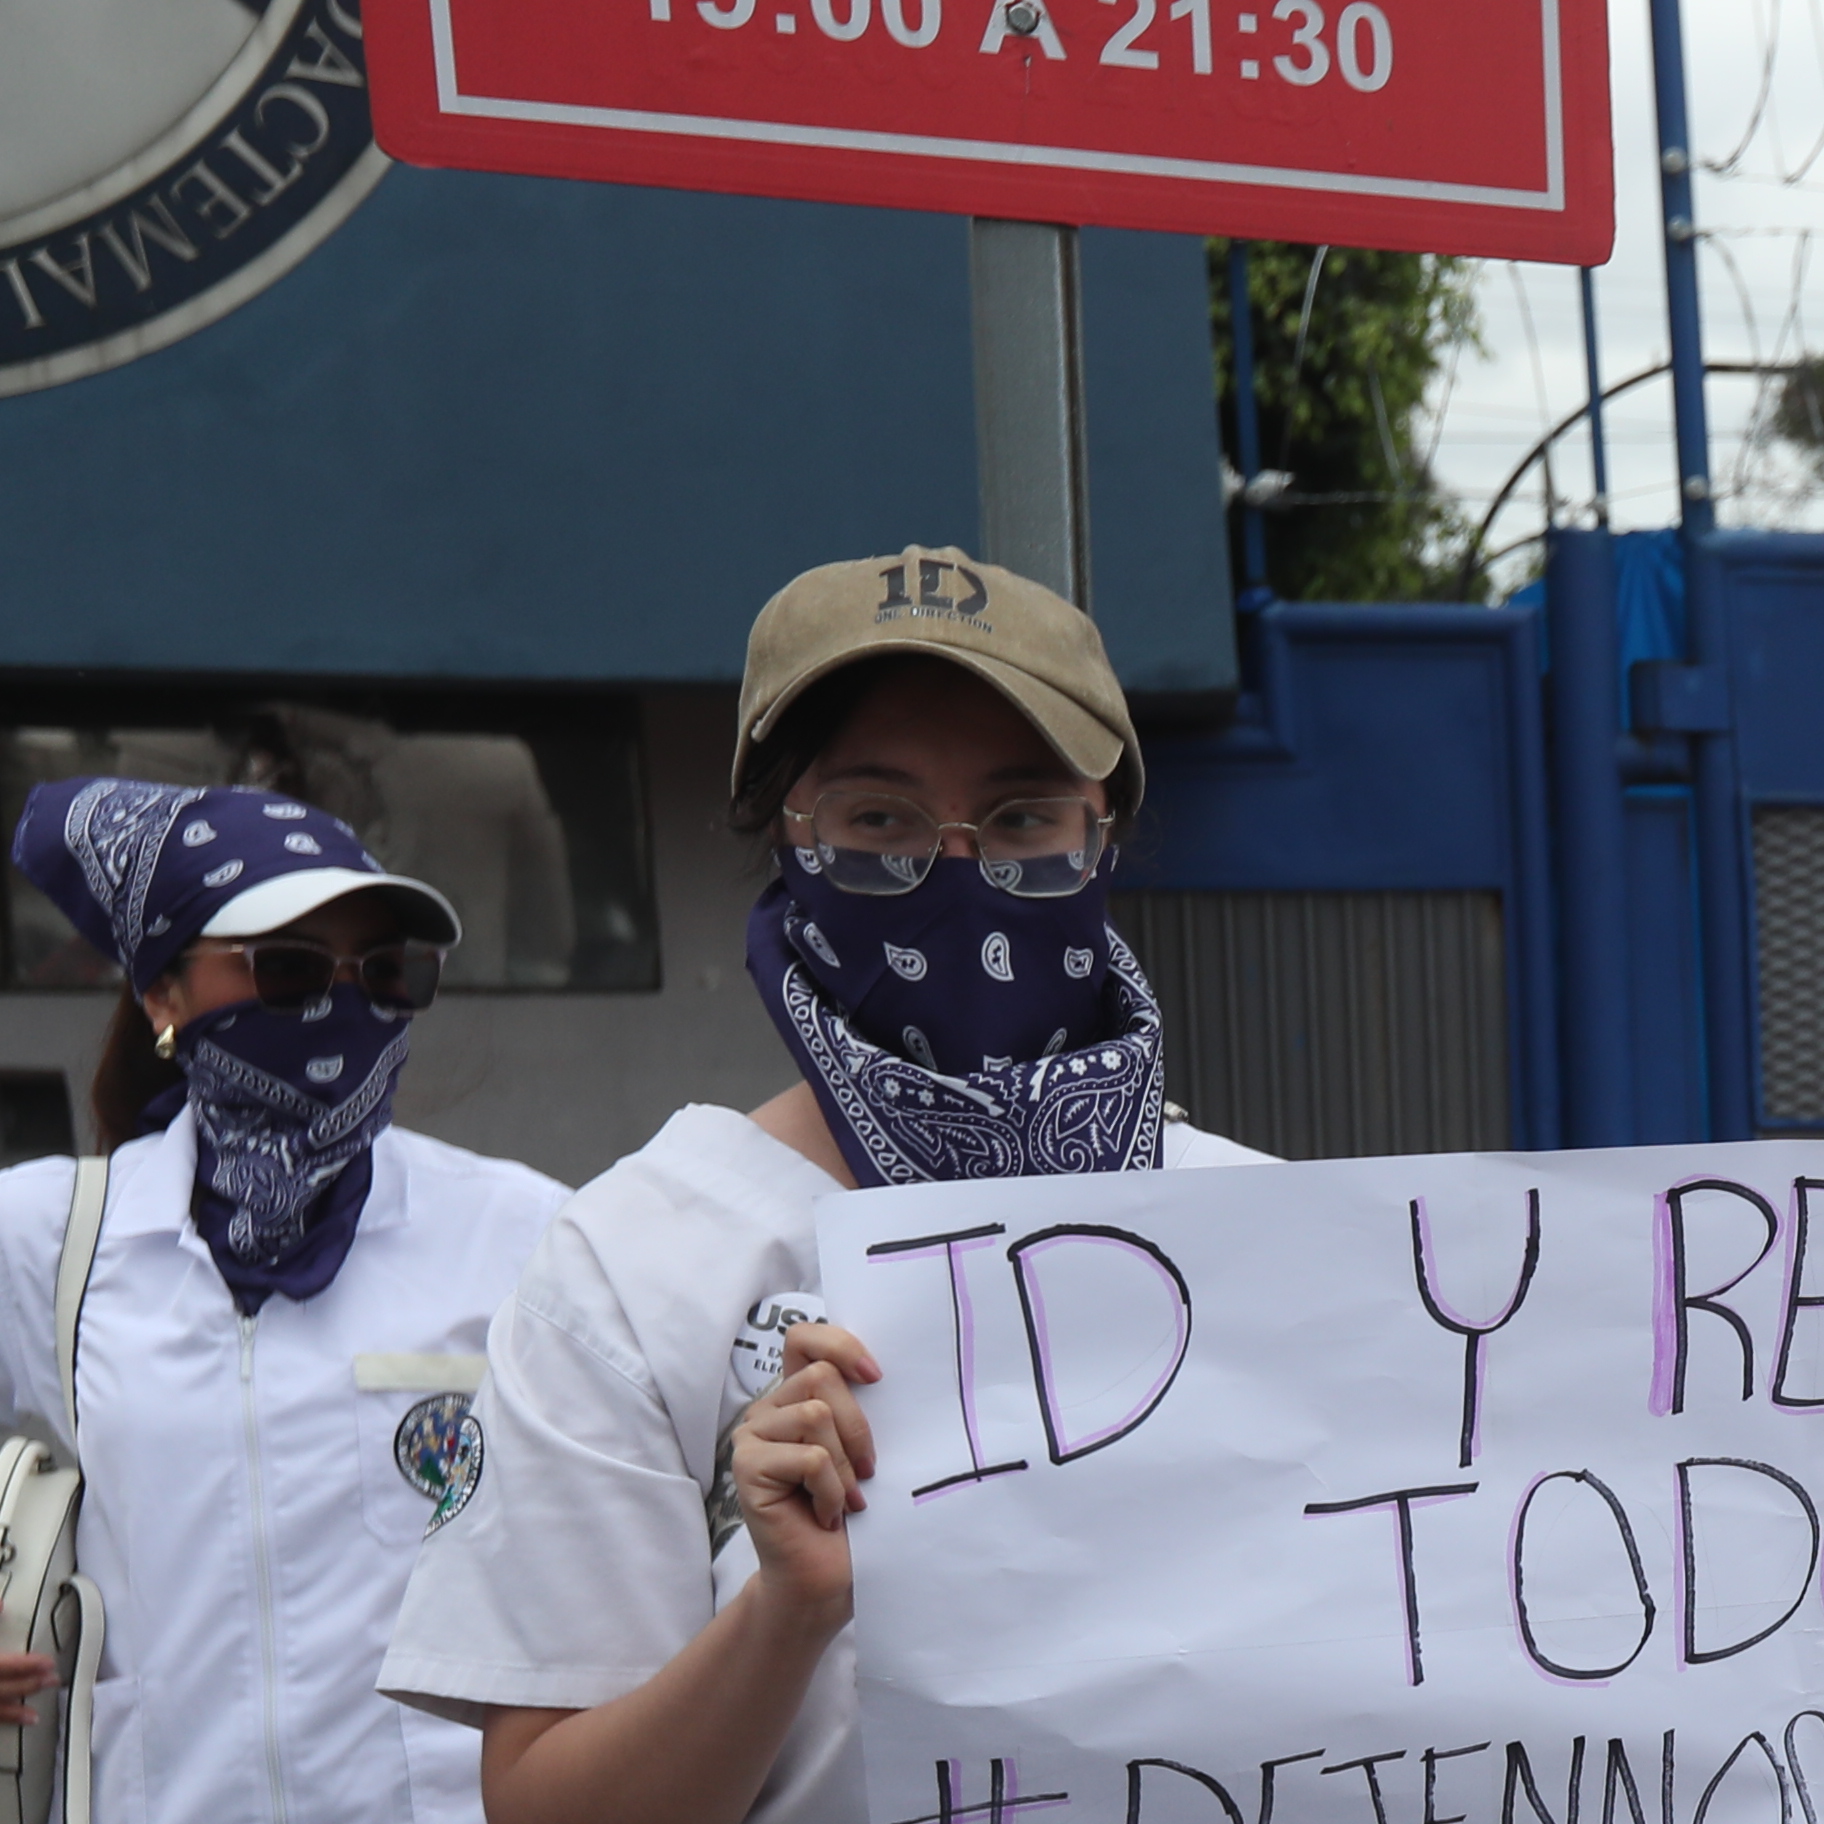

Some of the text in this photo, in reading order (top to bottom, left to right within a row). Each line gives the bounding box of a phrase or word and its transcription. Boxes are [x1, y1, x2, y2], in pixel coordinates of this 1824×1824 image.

[1099, 0, 1393, 93] 21:30
[746, 1303, 828, 1336] US
[866, 1222, 1192, 1503] ID
[1409, 1186, 1540, 1468] Y
